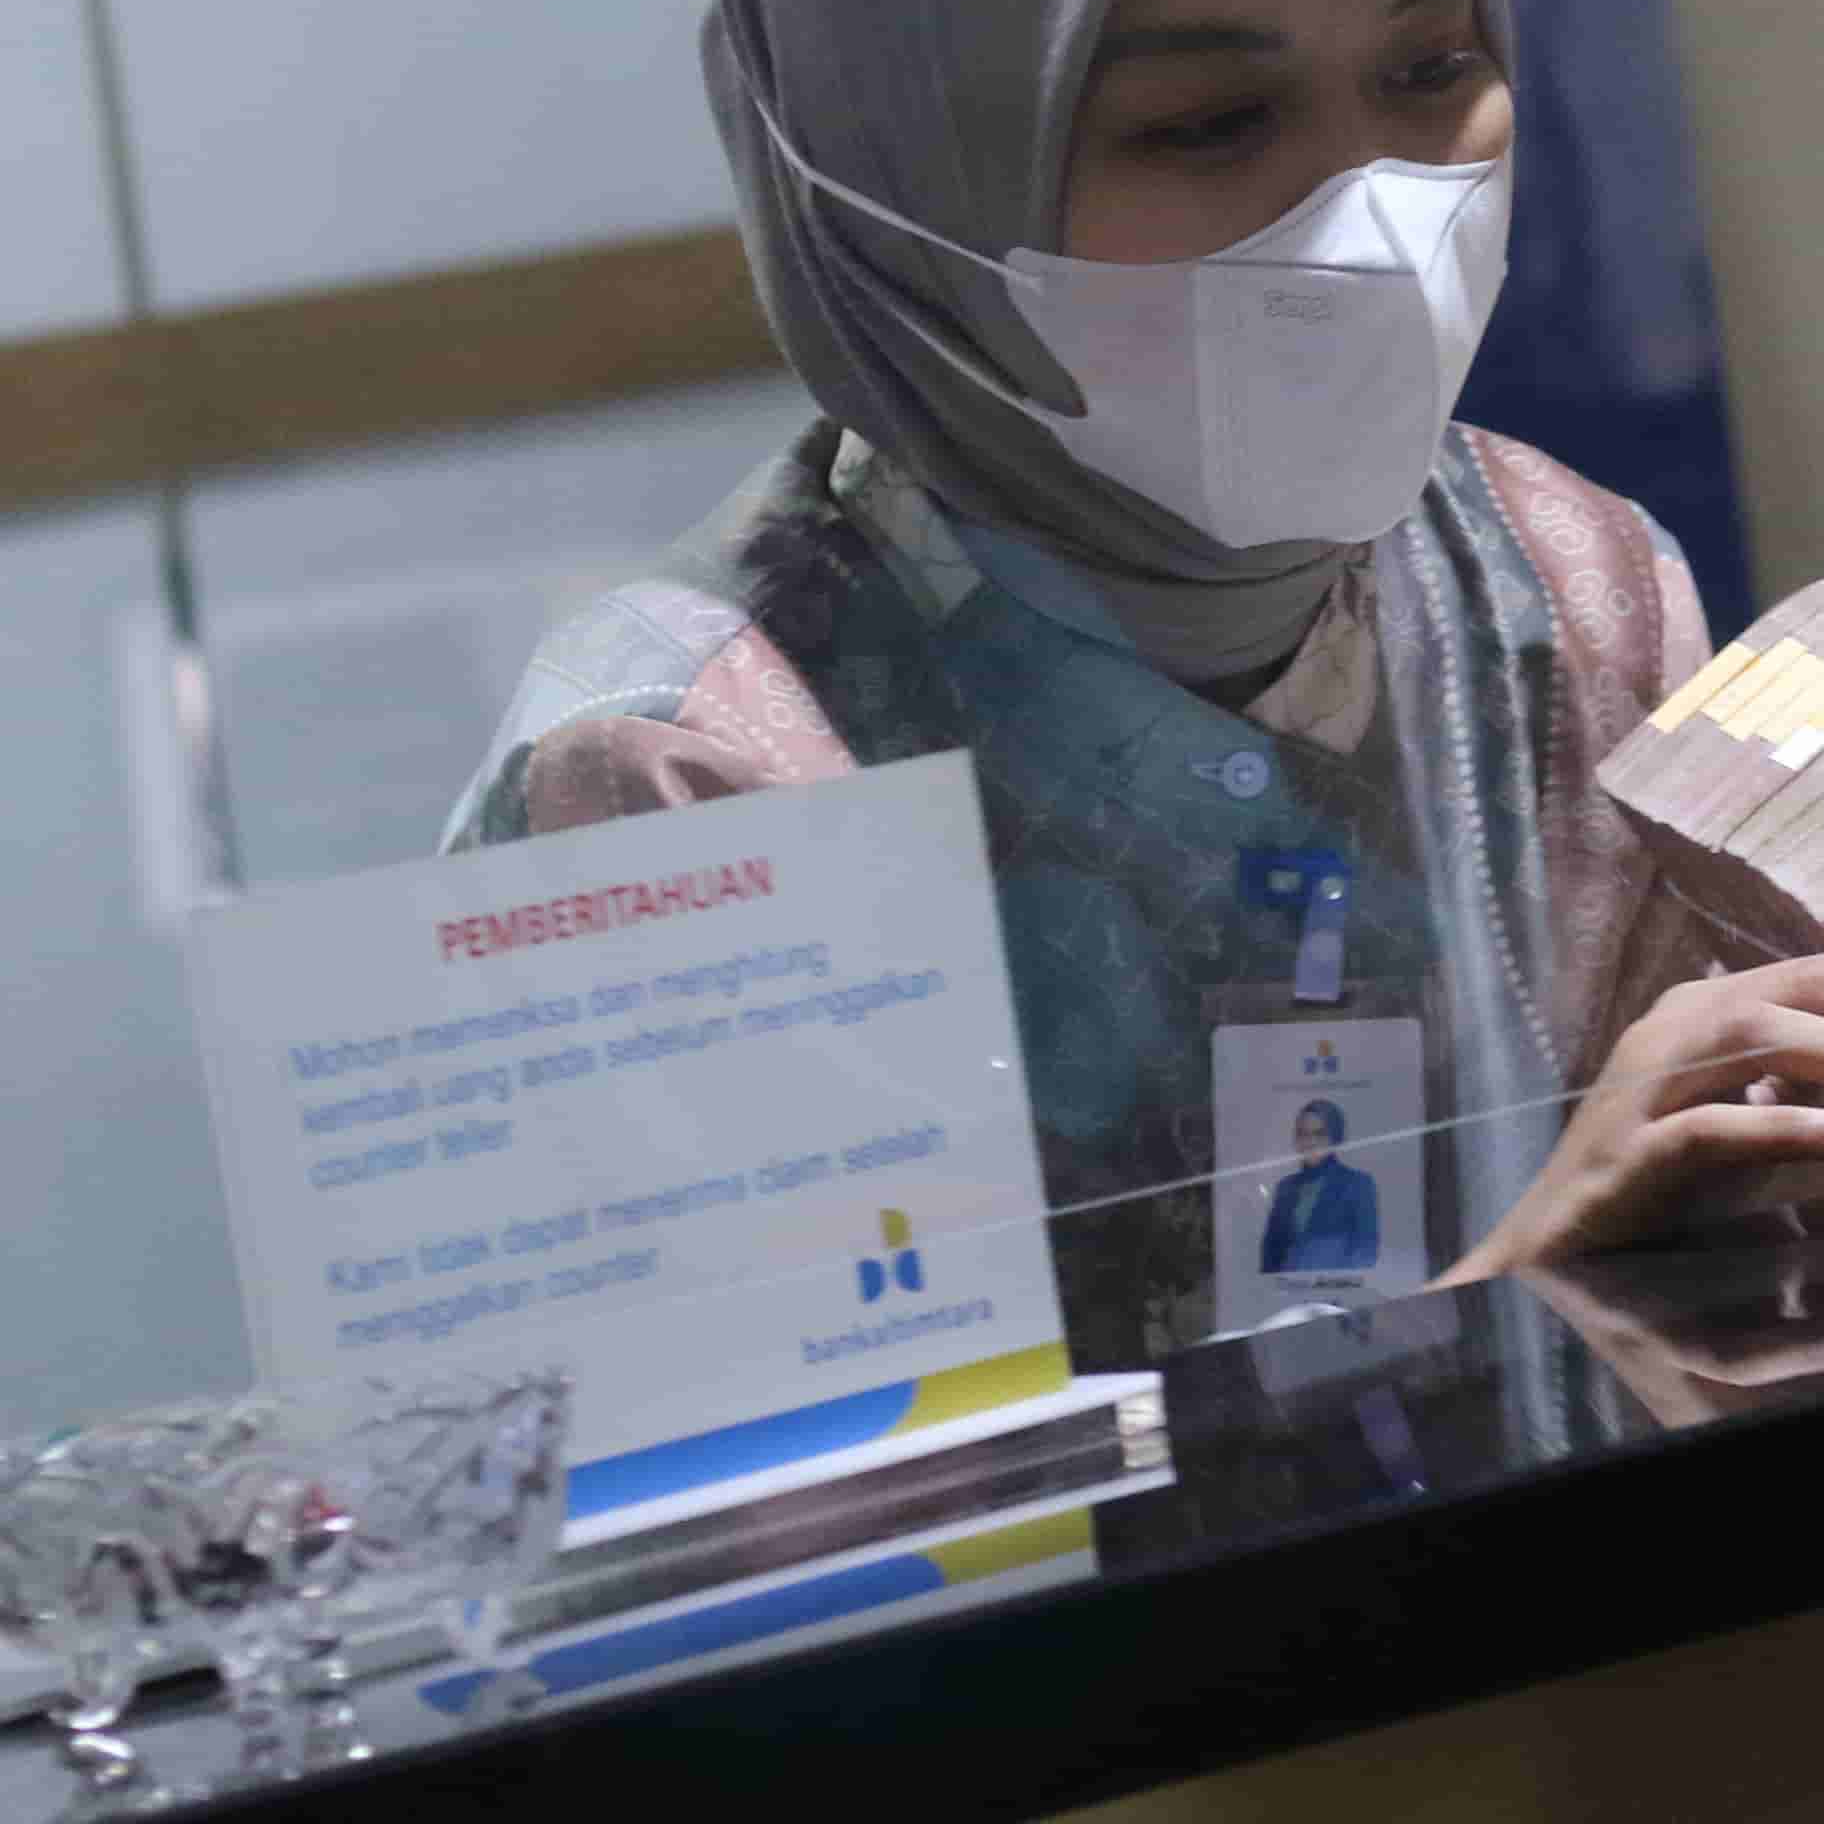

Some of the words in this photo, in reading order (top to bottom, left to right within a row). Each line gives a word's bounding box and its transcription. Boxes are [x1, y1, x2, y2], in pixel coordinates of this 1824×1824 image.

[436, 856, 774, 961] PEMBERITAHUAN
[288, 1036, 400, 1080] Mohon
[408, 1000, 580, 1055] memeriksa
[591, 979, 644, 1016] dan
[652, 942, 832, 998] menghitung
[432, 1066, 513, 1106] uang
[305, 1138, 430, 1189] counter
[325, 1254, 414, 1295] Kami
